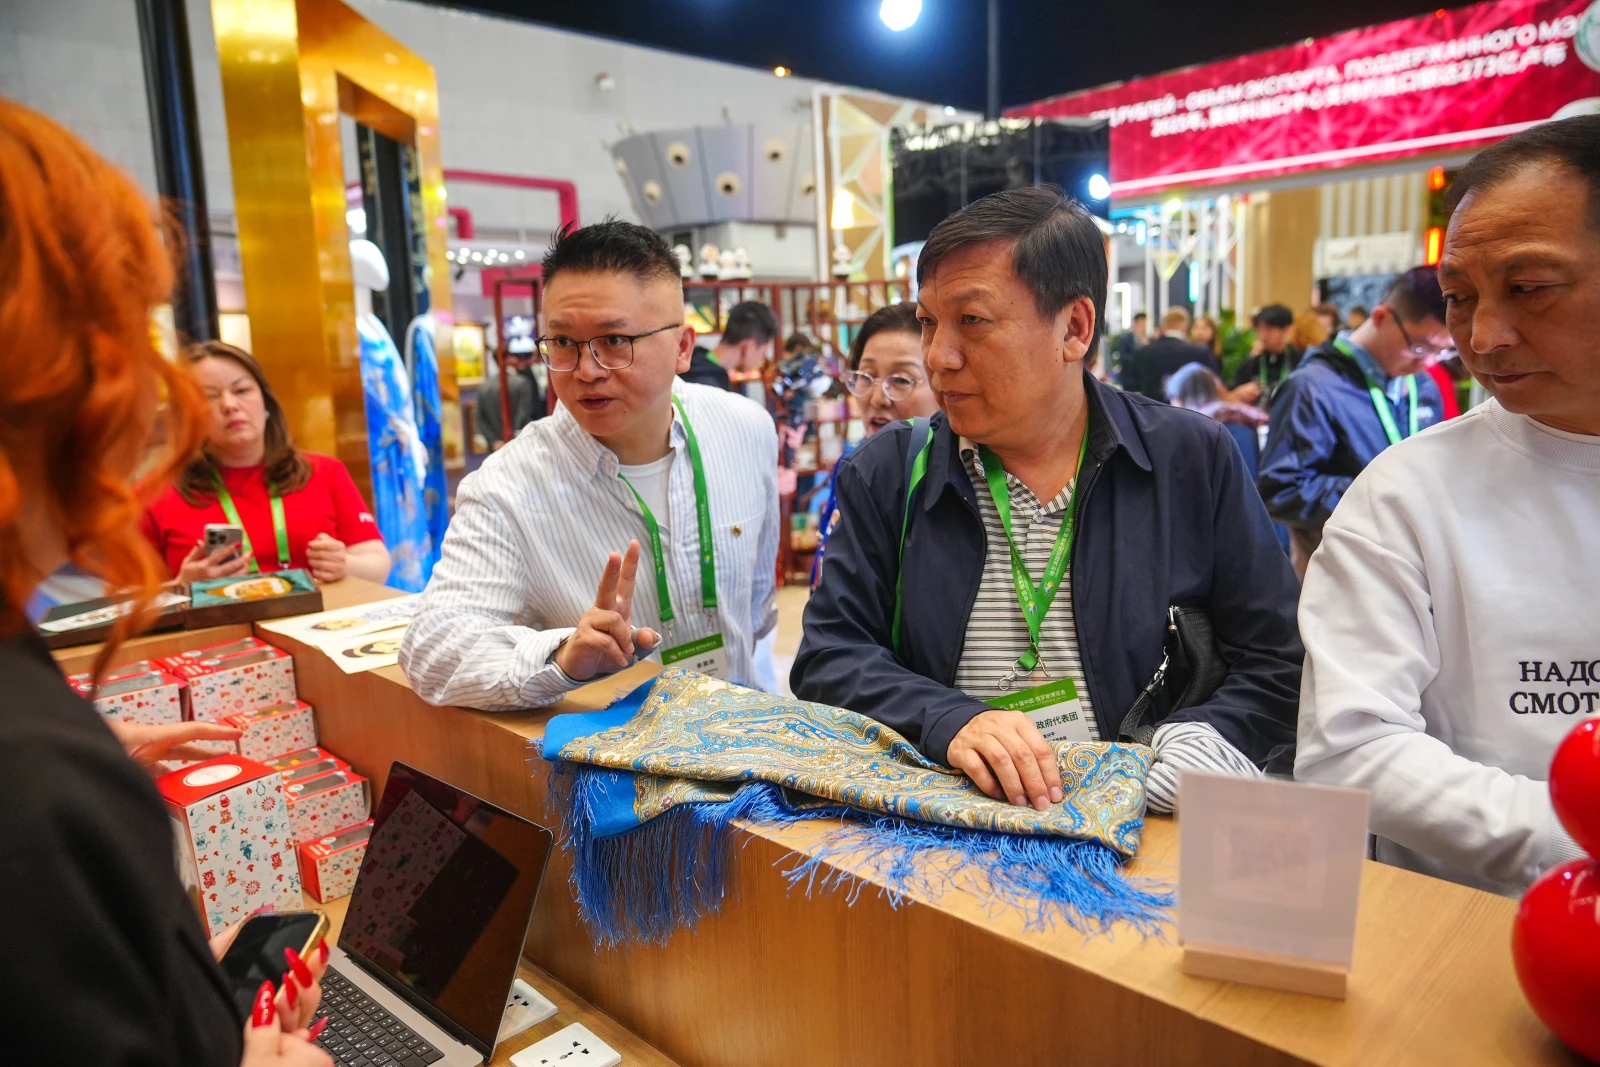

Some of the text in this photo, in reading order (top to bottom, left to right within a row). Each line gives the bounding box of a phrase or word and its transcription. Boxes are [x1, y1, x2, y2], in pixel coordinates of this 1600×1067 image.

[1035, 711, 1079, 730] 政府代表团
